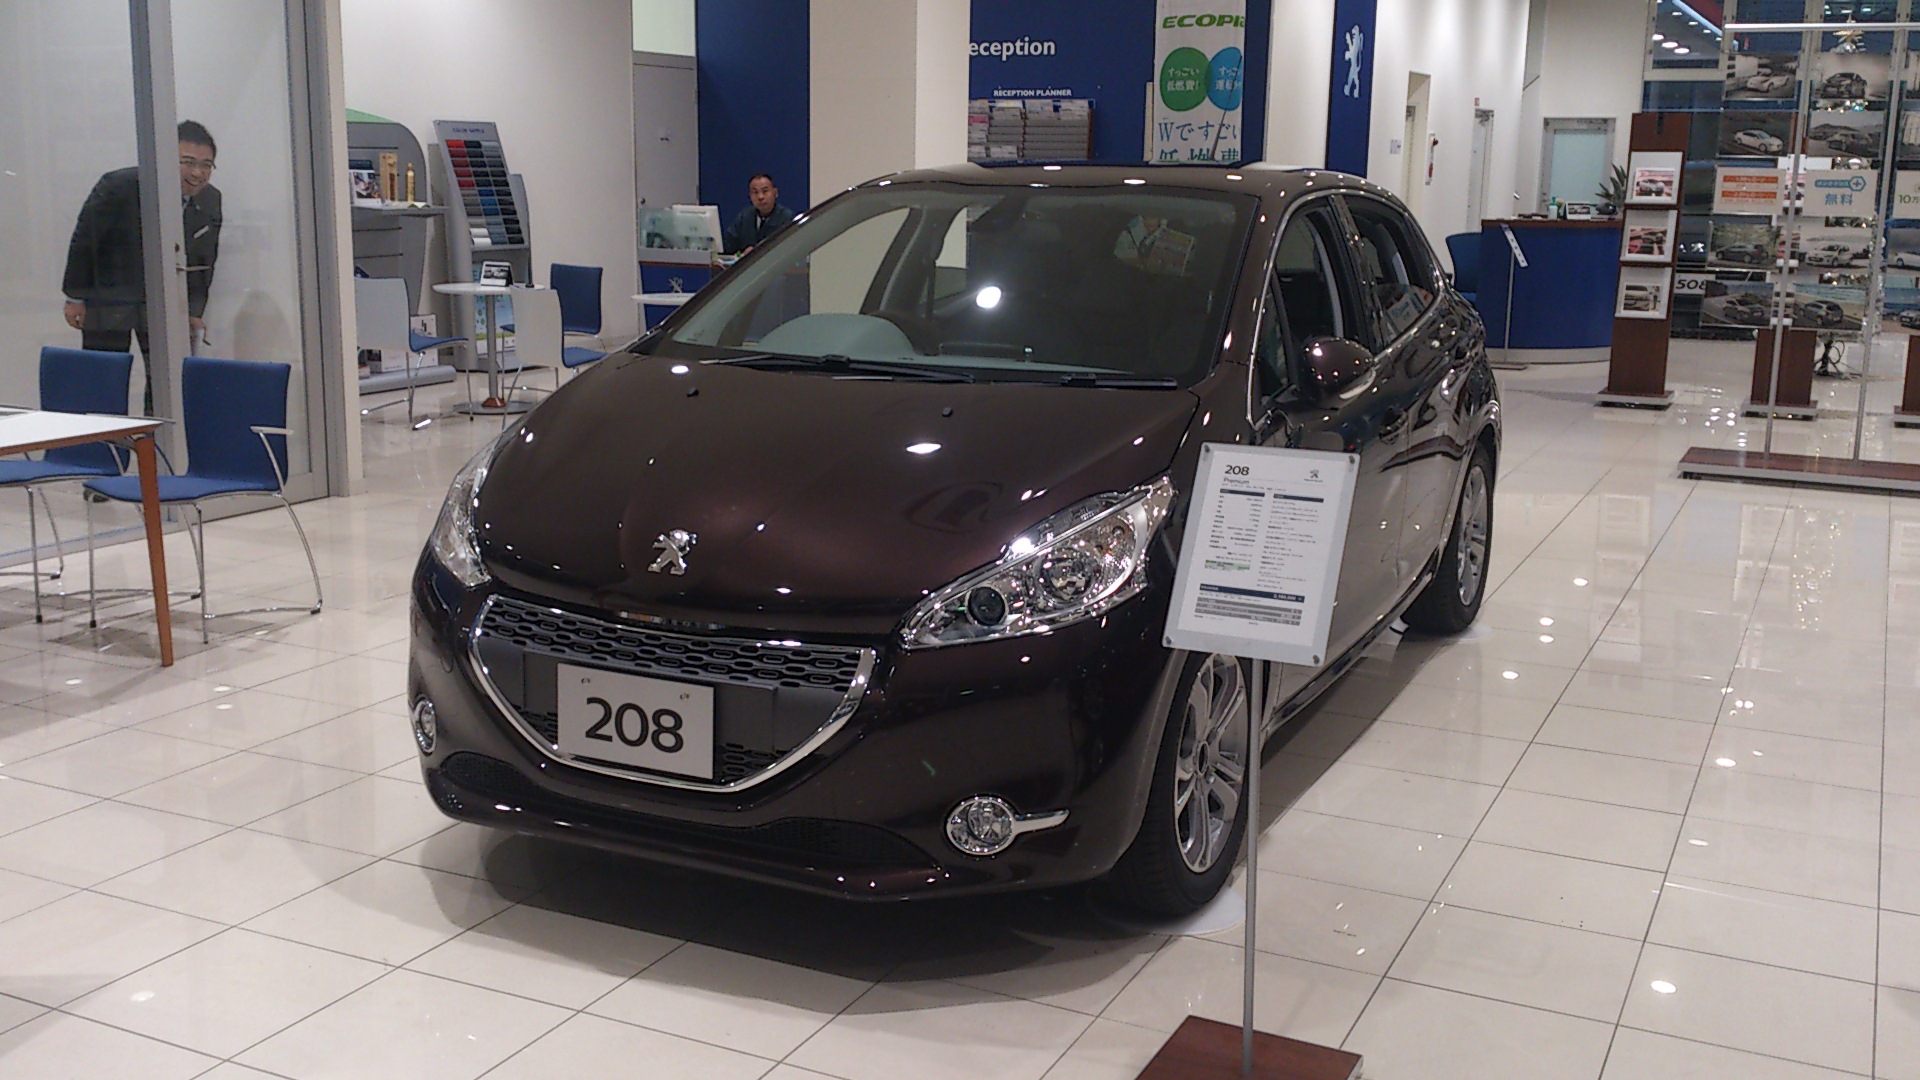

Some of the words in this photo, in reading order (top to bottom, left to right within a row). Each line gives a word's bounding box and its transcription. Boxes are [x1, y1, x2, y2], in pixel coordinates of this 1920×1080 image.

[969, 36, 1056, 61] eception
[1825, 193, 1853, 205] 無料
[1224, 464, 1250, 476] 208
[585, 696, 684, 753] 208
